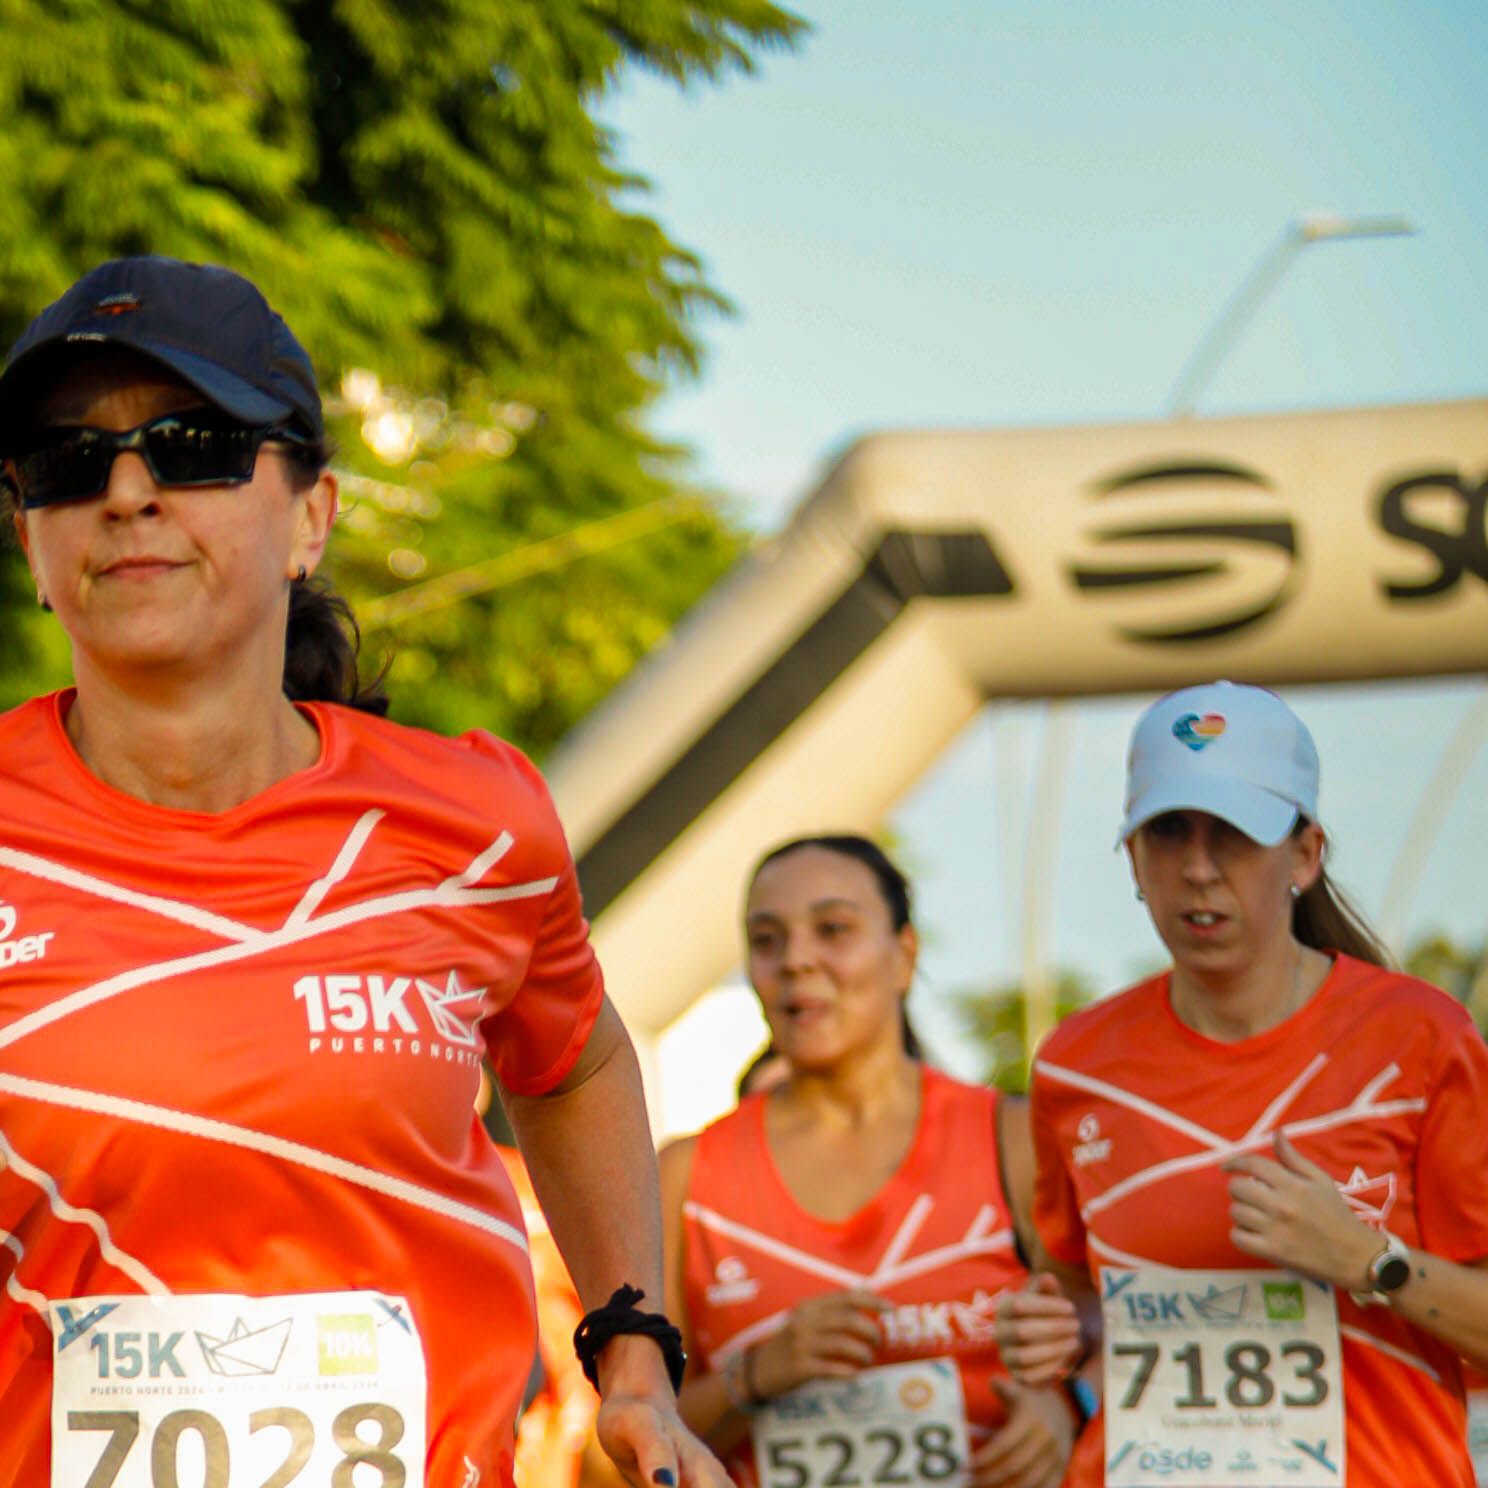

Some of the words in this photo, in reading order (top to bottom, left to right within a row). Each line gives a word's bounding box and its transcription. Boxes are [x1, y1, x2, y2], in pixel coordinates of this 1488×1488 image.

[1374, 466, 1488, 602] S
[293, 975, 419, 1034] 15K
[310, 1037, 422, 1055] PUERTO
[1124, 1292, 1184, 1321] 15K
[90, 1331, 187, 1378] 15K
[1112, 1340, 1330, 1409] 7183
